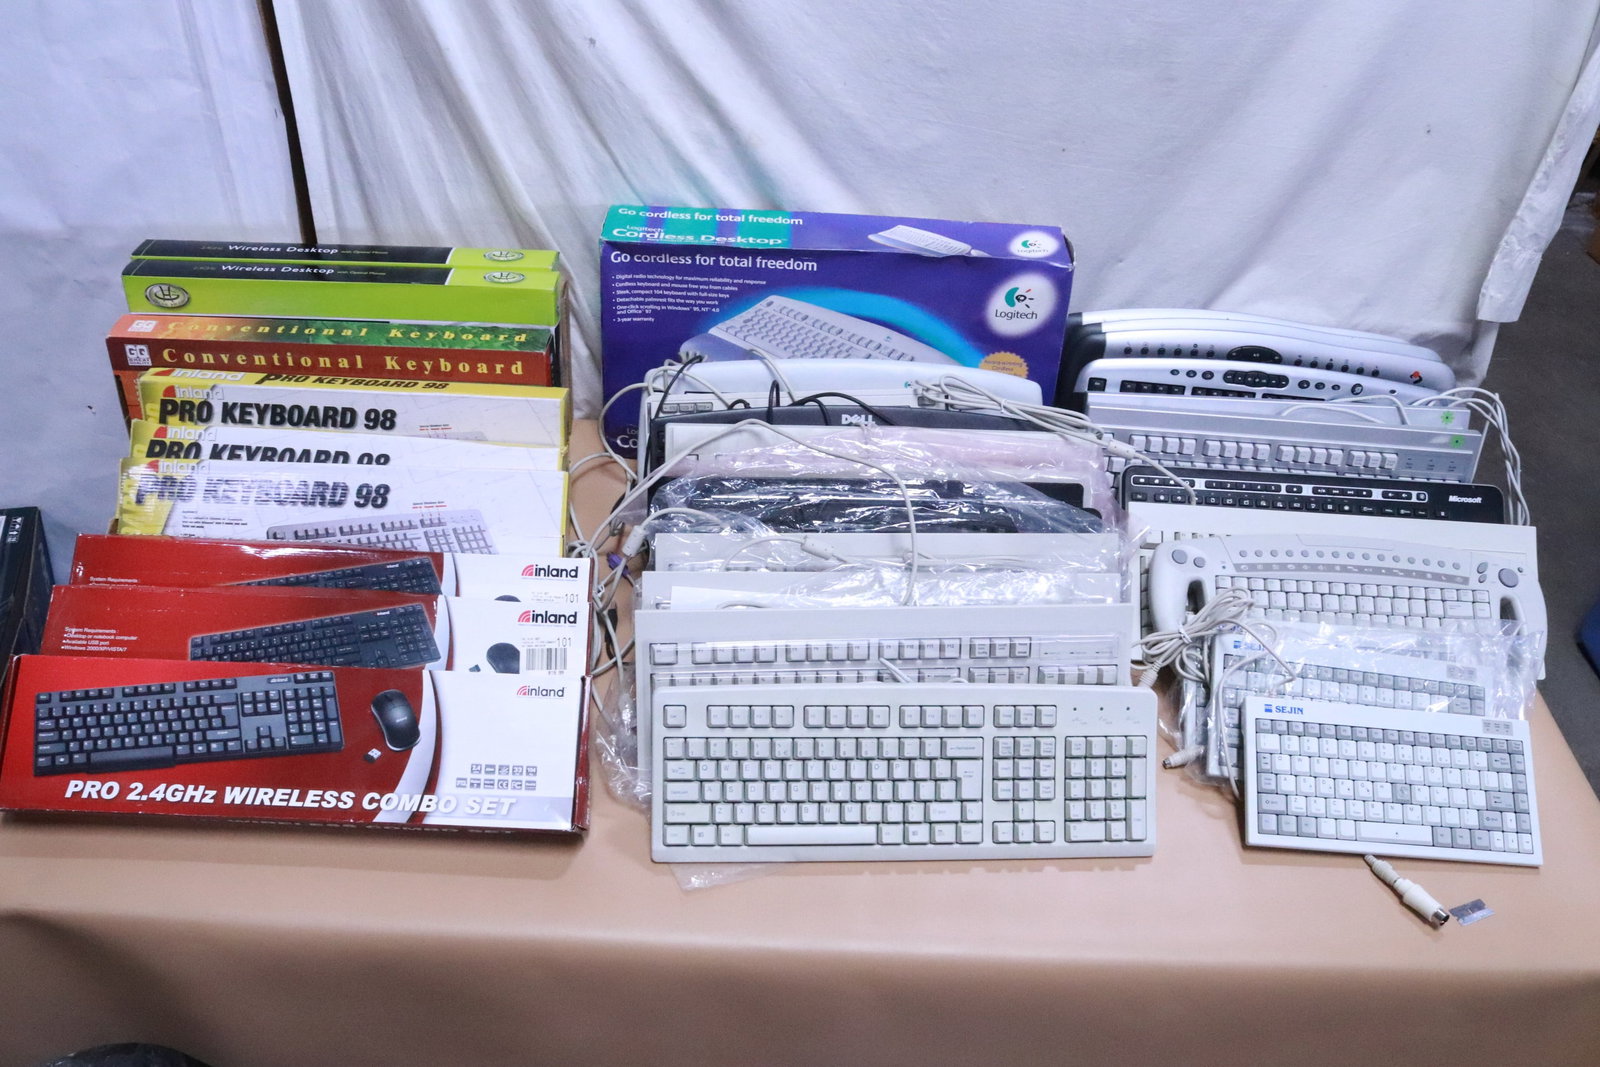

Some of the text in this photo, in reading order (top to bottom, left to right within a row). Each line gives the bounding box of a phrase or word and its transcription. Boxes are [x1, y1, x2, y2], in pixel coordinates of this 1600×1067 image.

[639, 211, 691, 220] cordless
[694, 212, 713, 221] for
[716, 214, 745, 222] total
[748, 214, 803, 225] freedom
[612, 228, 695, 240] Cordless
[286, 246, 339, 254] Desktop
[610, 251, 817, 272] Go cordless for total freedom
[221, 264, 276, 273] Wireless
[281, 266, 335, 275] Desktop
[995, 309, 1038, 320] Logitech
[167, 321, 527, 343] Conventional Keyboard
[162, 348, 523, 375] Conventional Keyboard
[170, 368, 450, 390] inland PRO KEYBOARD 98
[175, 384, 225, 400] inland
[159, 398, 214, 425] PRO
[221, 402, 358, 429] KEYBOARD
[364, 408, 397, 431] 98
[841, 413, 876, 425] DELL
[167, 425, 218, 441] inland
[159, 459, 211, 474] inland
[202, 478, 349, 508] KEYBOARD
[354, 483, 391, 509] 98
[1448, 495, 1482, 504] Microsoft
[534, 564, 579, 579] inland
[564, 593, 579, 604] 101
[531, 610, 578, 625] inland
[556, 637, 572, 648] 101
[527, 686, 565, 698] inland
[1275, 705, 1304, 715] SEJIN
[65, 780, 517, 816] PRO 2.4GHz WIRELESS COMBO SET
